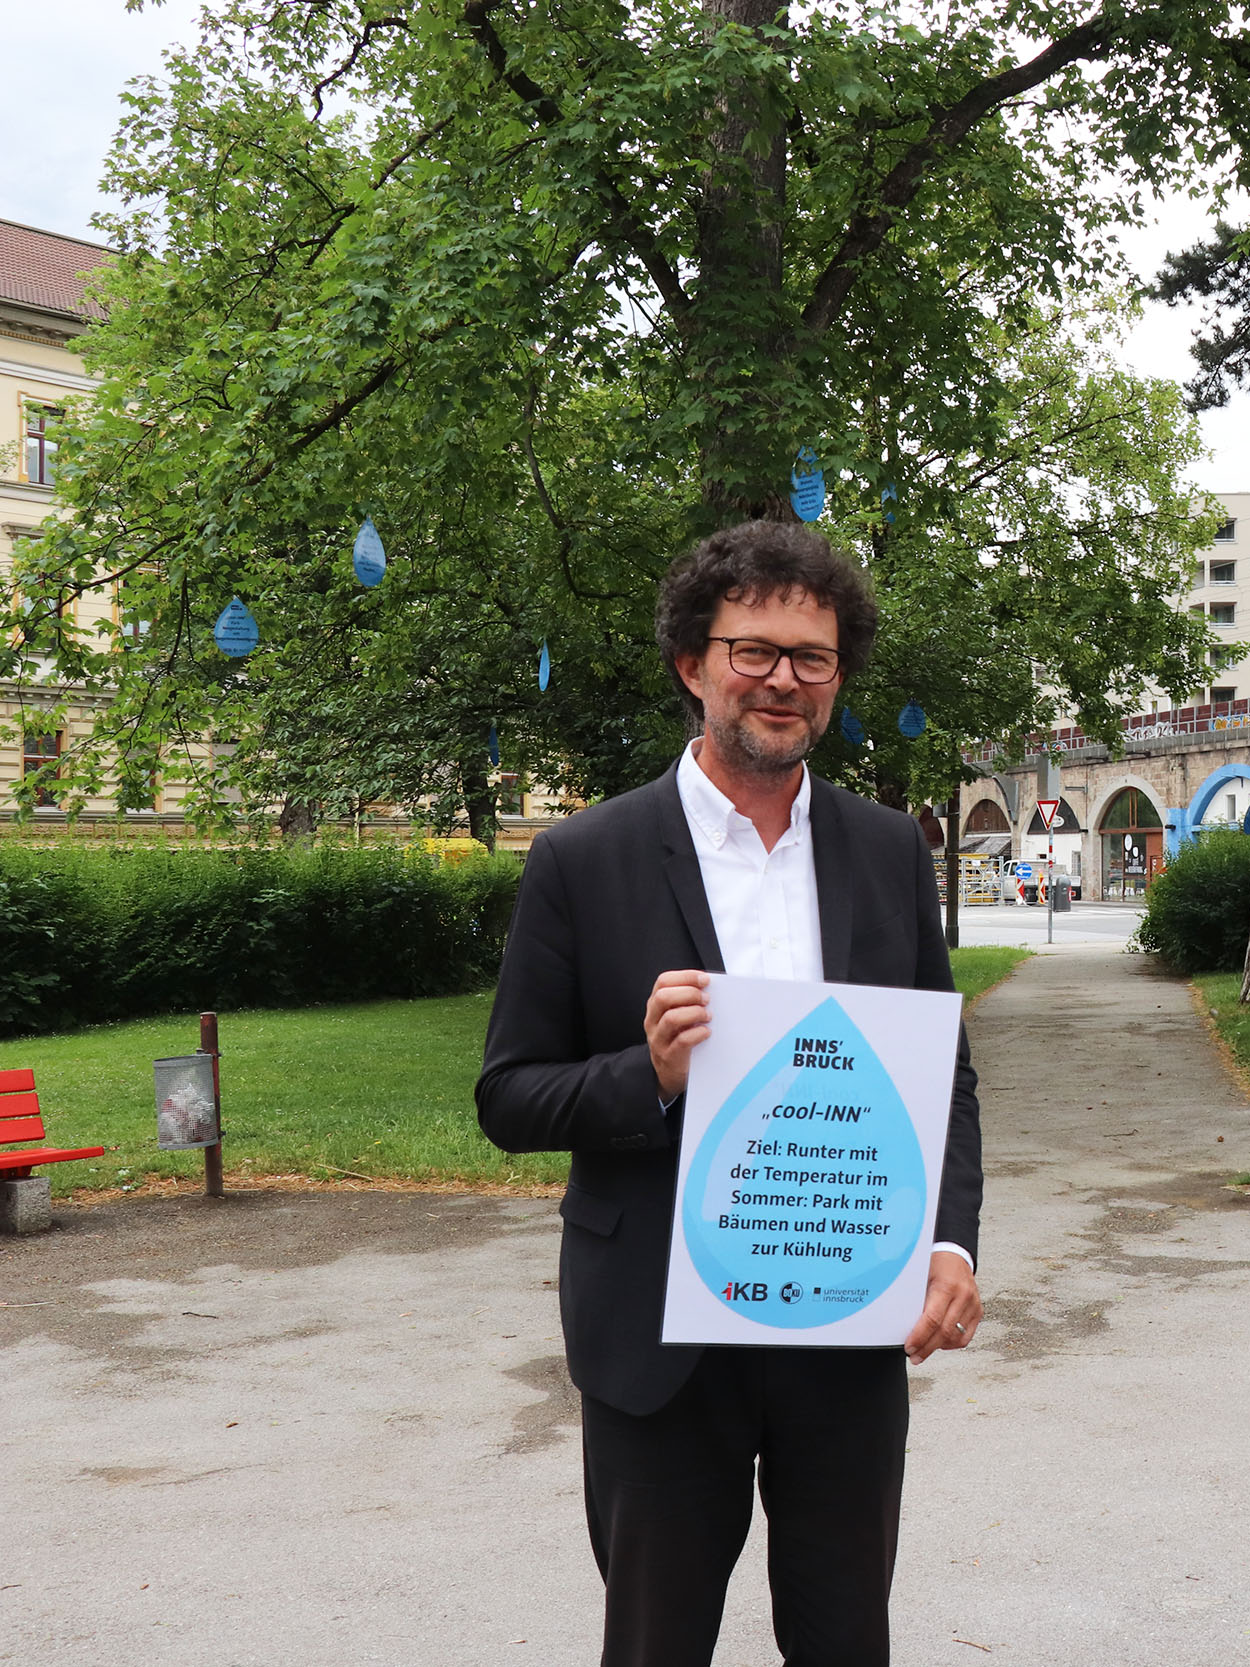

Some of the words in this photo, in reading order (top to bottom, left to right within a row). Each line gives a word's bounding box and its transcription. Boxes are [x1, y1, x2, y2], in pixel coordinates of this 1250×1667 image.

[792, 1054, 854, 1071] BRUCK
[746, 1140, 782, 1156] Ziel:
[787, 1142, 845, 1160] Runter
[849, 1145, 879, 1162] mit
[730, 1164, 759, 1180] der
[763, 1167, 862, 1188] Temperatur
[867, 1172, 888, 1186] im
[730, 1190, 808, 1207] Sommer:
[812, 1194, 850, 1209] Park
[854, 1195, 883, 1211] mit
[719, 1215, 789, 1231] Bäumen
[793, 1217, 826, 1233] und
[830, 1220, 891, 1236] Wasser
[751, 1242, 779, 1255] zur
[783, 1242, 853, 1262] Kühlung
[823, 1295, 864, 1303] innsbruck
[824, 1288, 869, 1296] universität
